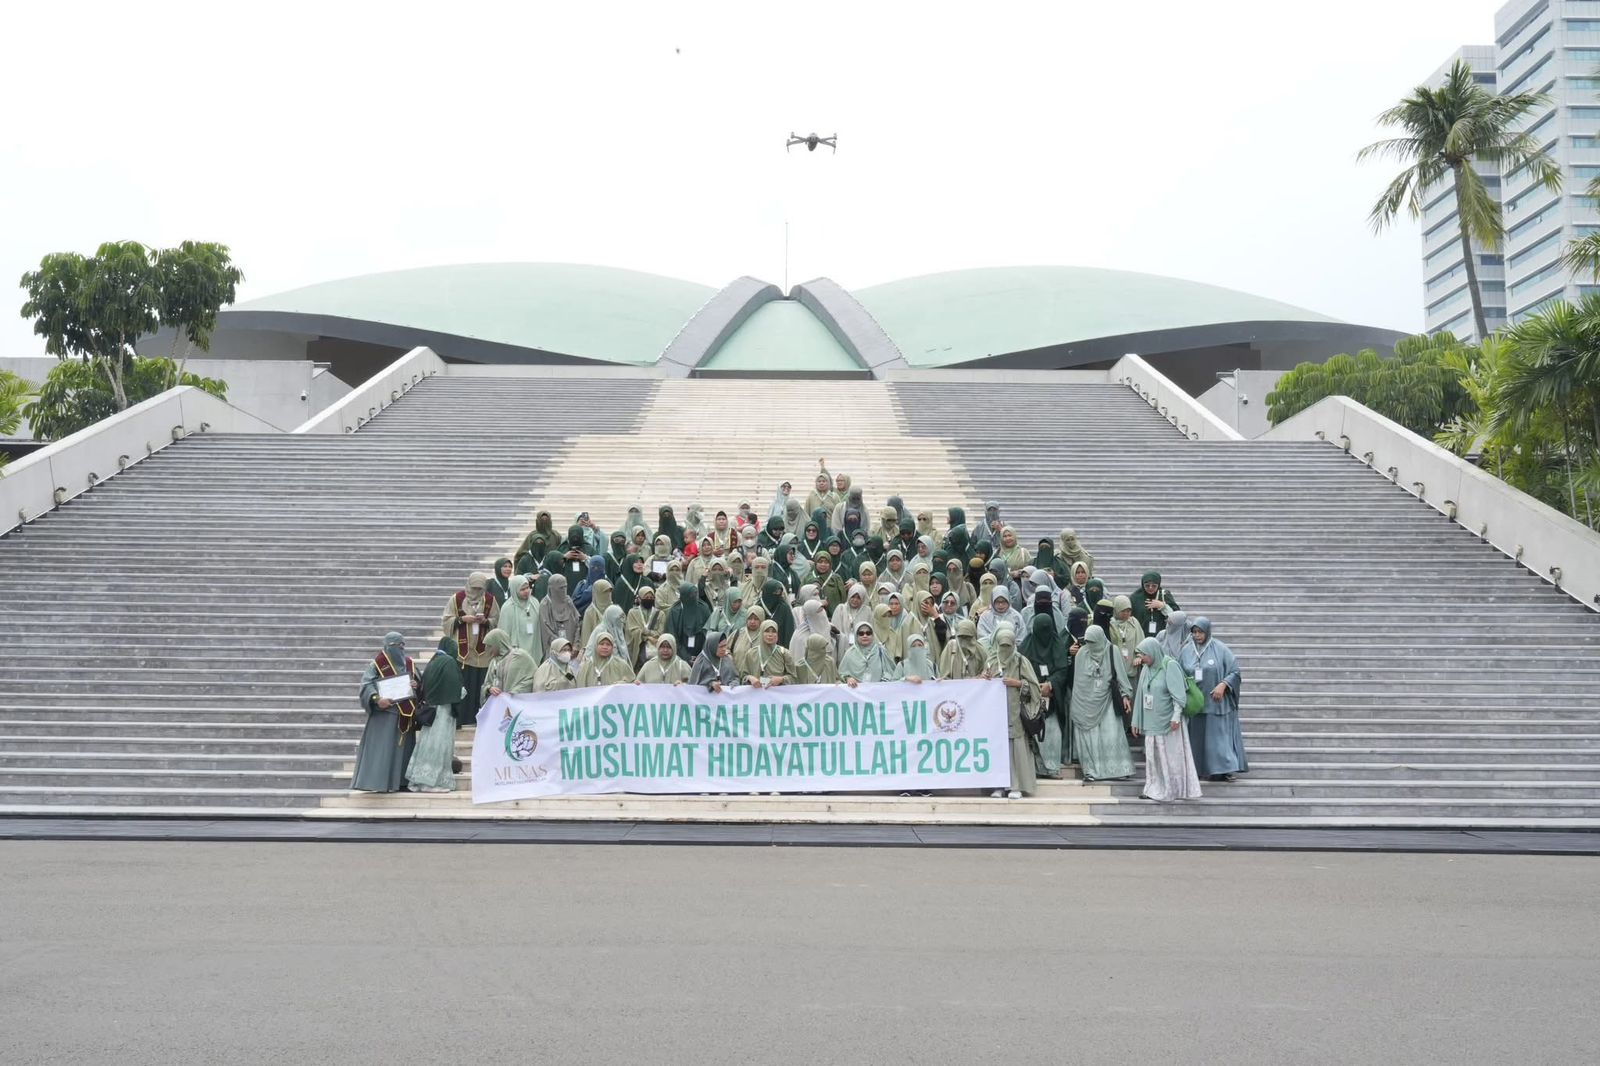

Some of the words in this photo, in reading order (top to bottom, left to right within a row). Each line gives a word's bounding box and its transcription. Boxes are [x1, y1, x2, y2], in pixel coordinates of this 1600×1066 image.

[558, 704, 749, 742] MUSYAWARAH
[759, 701, 894, 738] NASIONAL
[902, 700, 927, 735] VI
[494, 765, 548, 780] MUNAS
[560, 743, 698, 780] MUSLIMAT
[707, 740, 907, 777] HIDAYATULLAH
[916, 738, 990, 774] 2025
